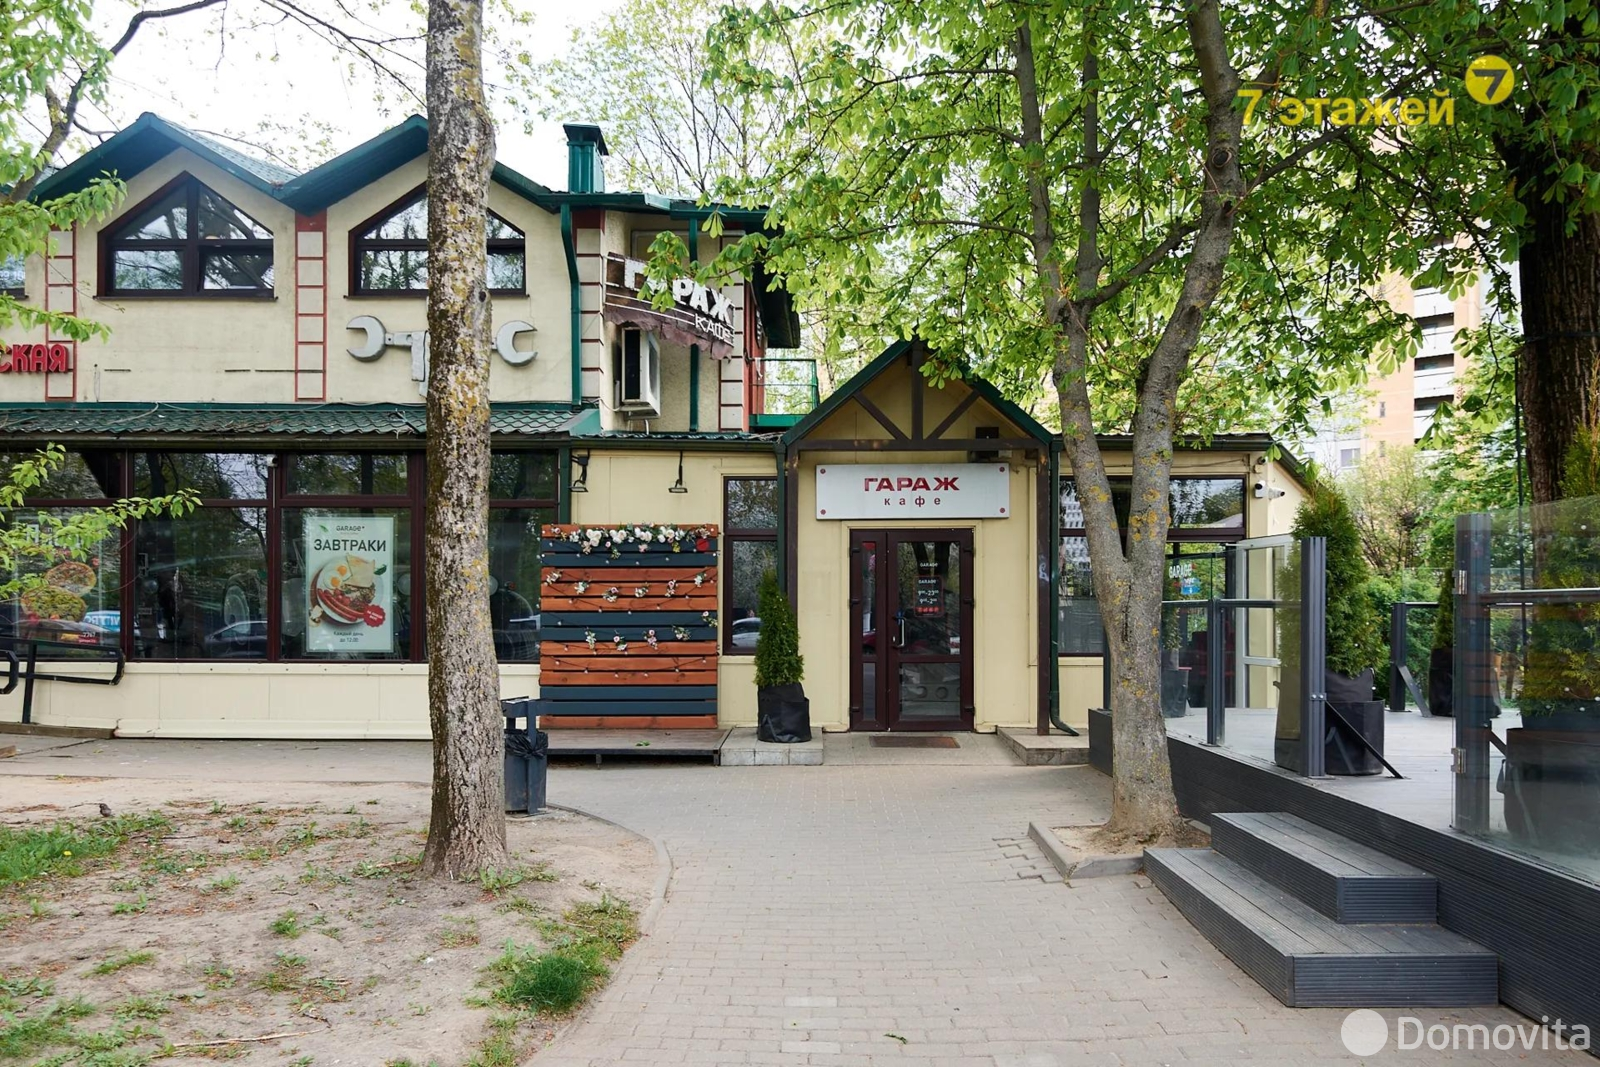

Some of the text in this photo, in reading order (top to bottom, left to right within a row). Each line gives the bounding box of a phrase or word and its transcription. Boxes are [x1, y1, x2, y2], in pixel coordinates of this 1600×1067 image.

[694, 313, 734, 342] КАФЕ
[864, 477, 960, 492] ГАРАЖ
[884, 496, 941, 507] кафе
[314, 538, 386, 552] ЗАВТРАКИ
